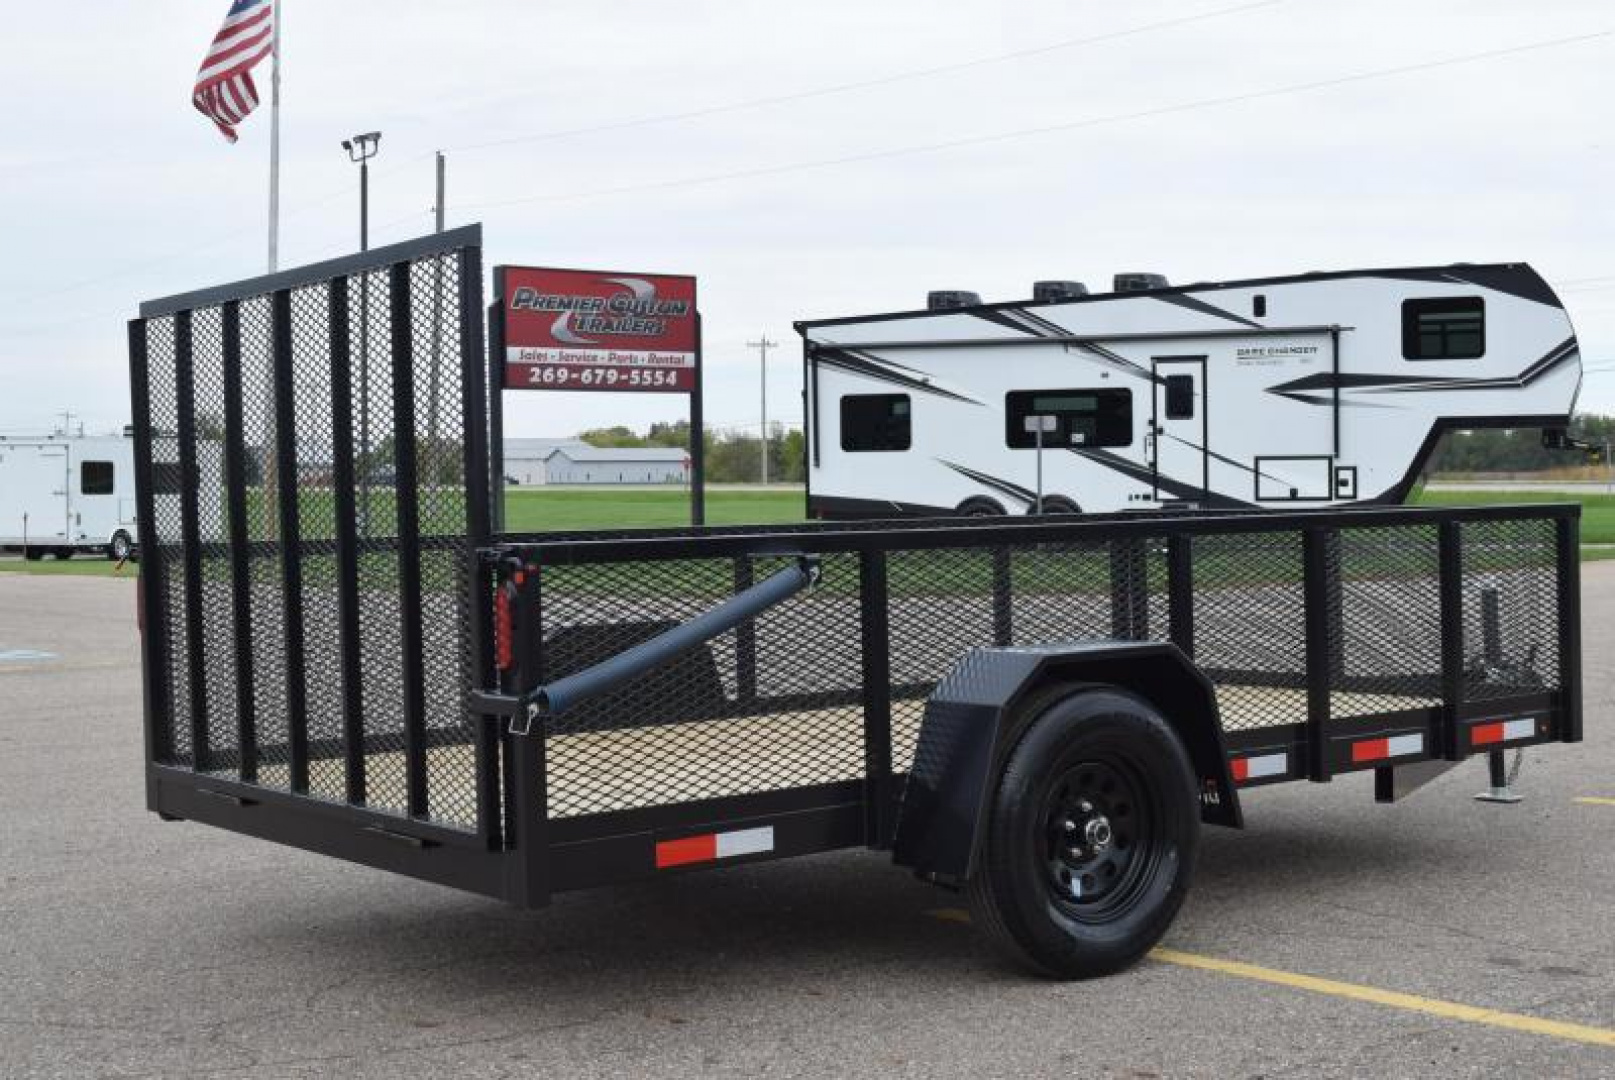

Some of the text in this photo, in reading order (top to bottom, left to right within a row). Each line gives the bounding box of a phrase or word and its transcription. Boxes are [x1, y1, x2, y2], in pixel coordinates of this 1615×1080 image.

[511, 287, 605, 312] PREMIER
[519, 348, 685, 364] Sales Service Parts Rental
[529, 366, 677, 387] 269-679-5554
